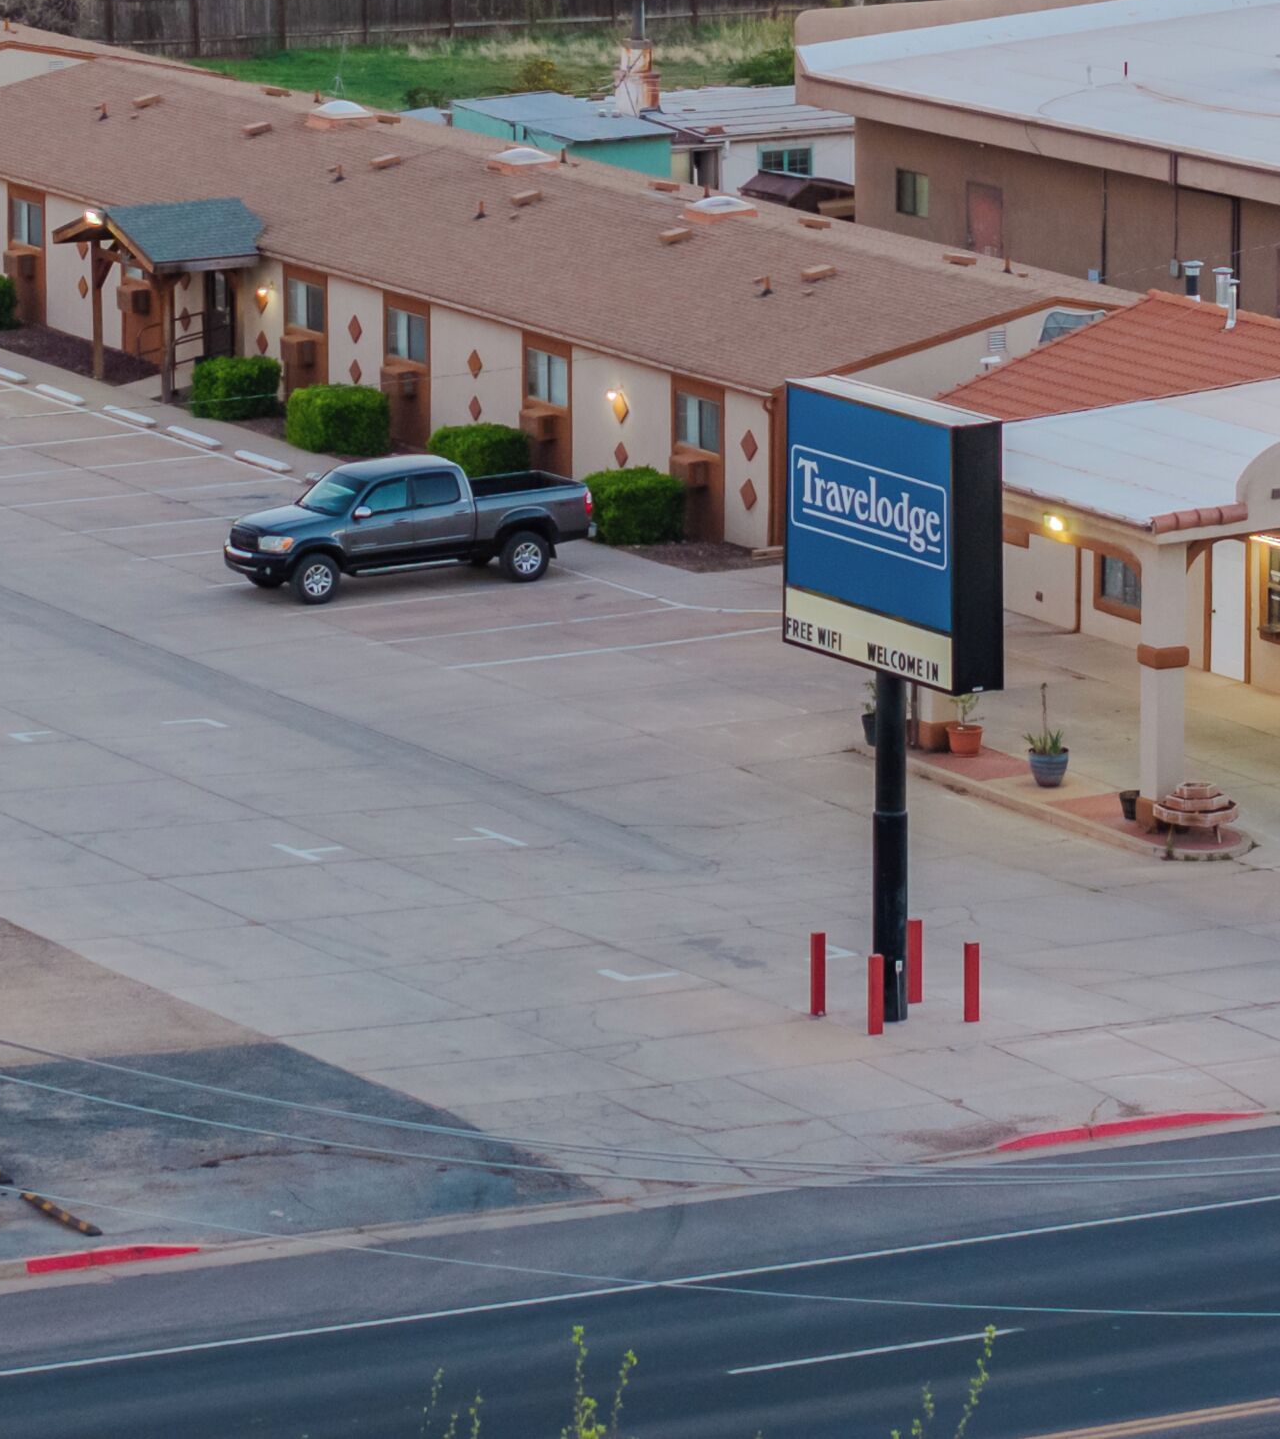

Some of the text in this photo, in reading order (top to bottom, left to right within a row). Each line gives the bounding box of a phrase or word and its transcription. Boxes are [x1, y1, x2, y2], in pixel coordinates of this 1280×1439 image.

[797, 457, 941, 553] Travelodge
[786, 616, 939, 682] FREE WIFI WELCOME IN
